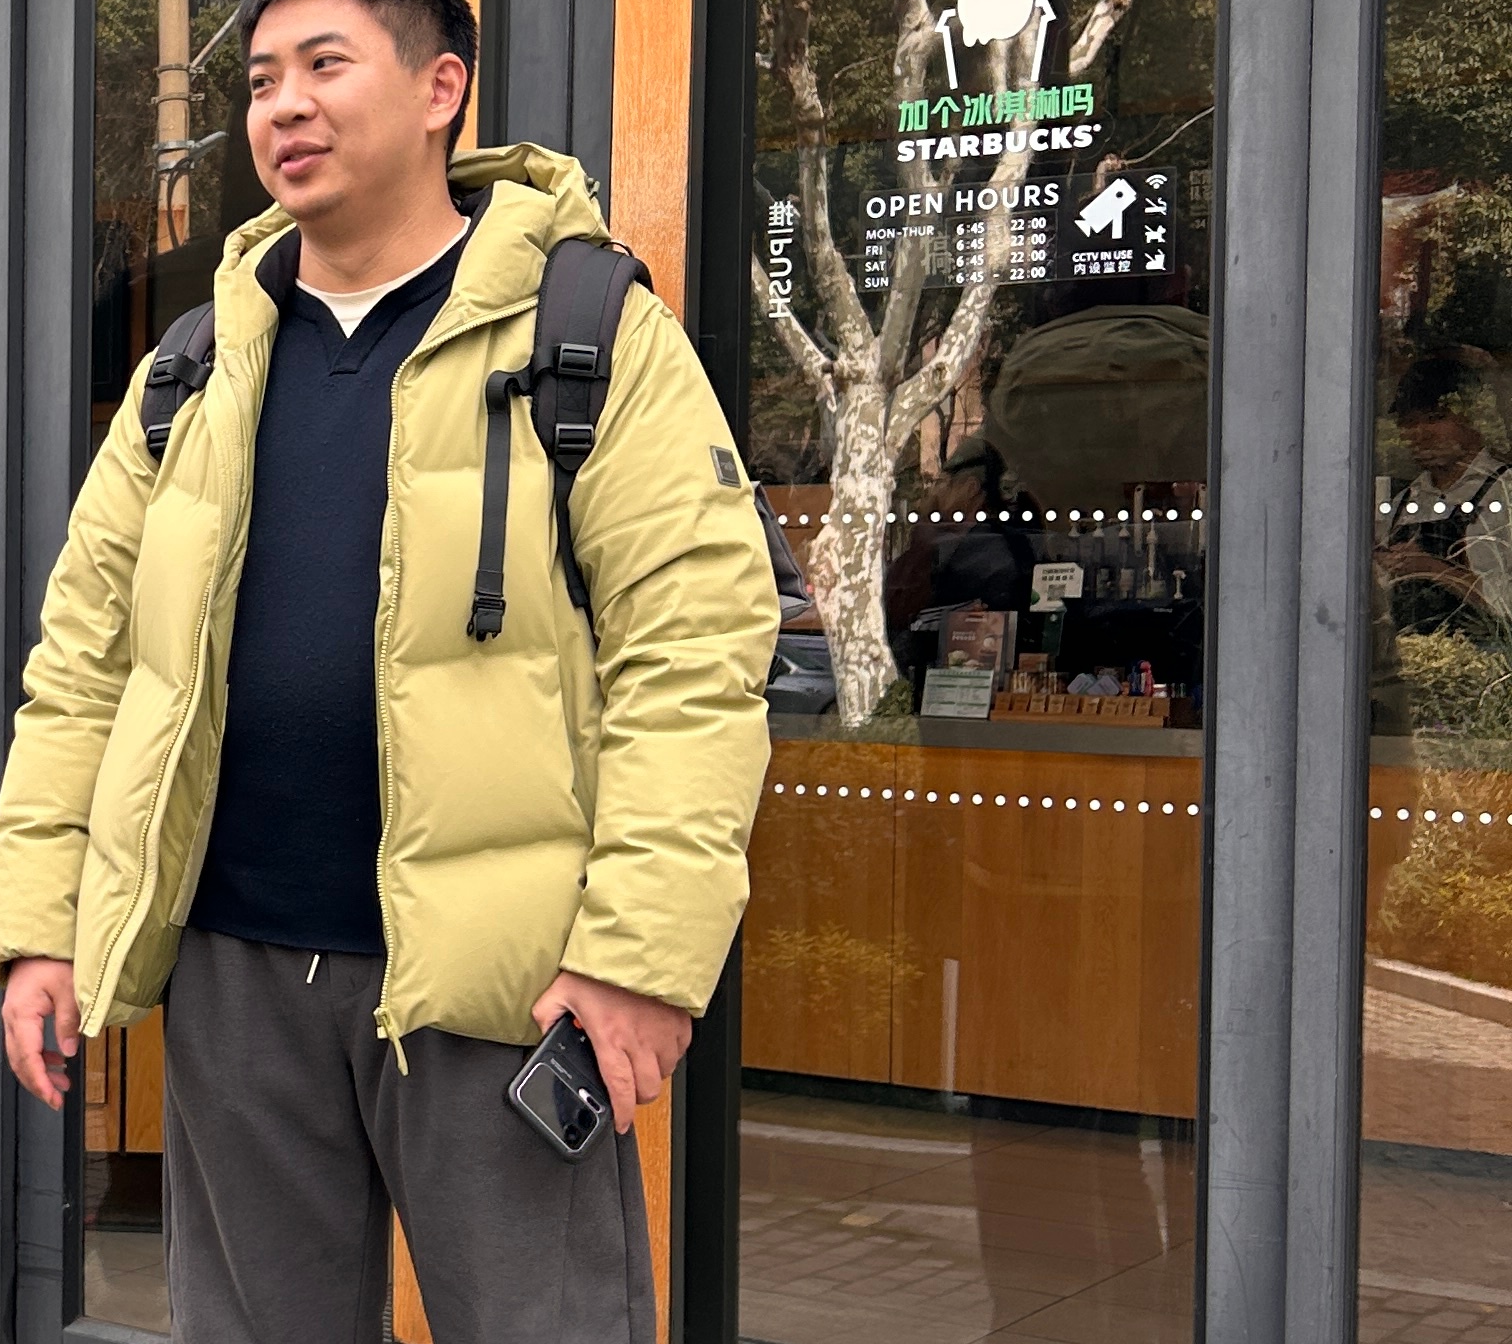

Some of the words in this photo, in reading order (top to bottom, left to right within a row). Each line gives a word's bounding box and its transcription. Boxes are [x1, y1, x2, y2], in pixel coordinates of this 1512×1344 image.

[898, 84, 1093, 132] 加个冰淇淋吗
[897, 124, 1094, 162] STARBUCKS
[866, 193, 942, 218] OPEN
[955, 183, 1059, 212] HOURS
[865, 225, 935, 240] MON-THUR
[865, 245, 883, 256] FRI
[1072, 251, 1099, 262] CCTV
[1100, 250, 1112, 260] IN
[1113, 249, 1133, 260] USE
[865, 260, 886, 272] SAT
[1074, 260, 1131, 275] 内设监控
[865, 277, 889, 288] SUN
